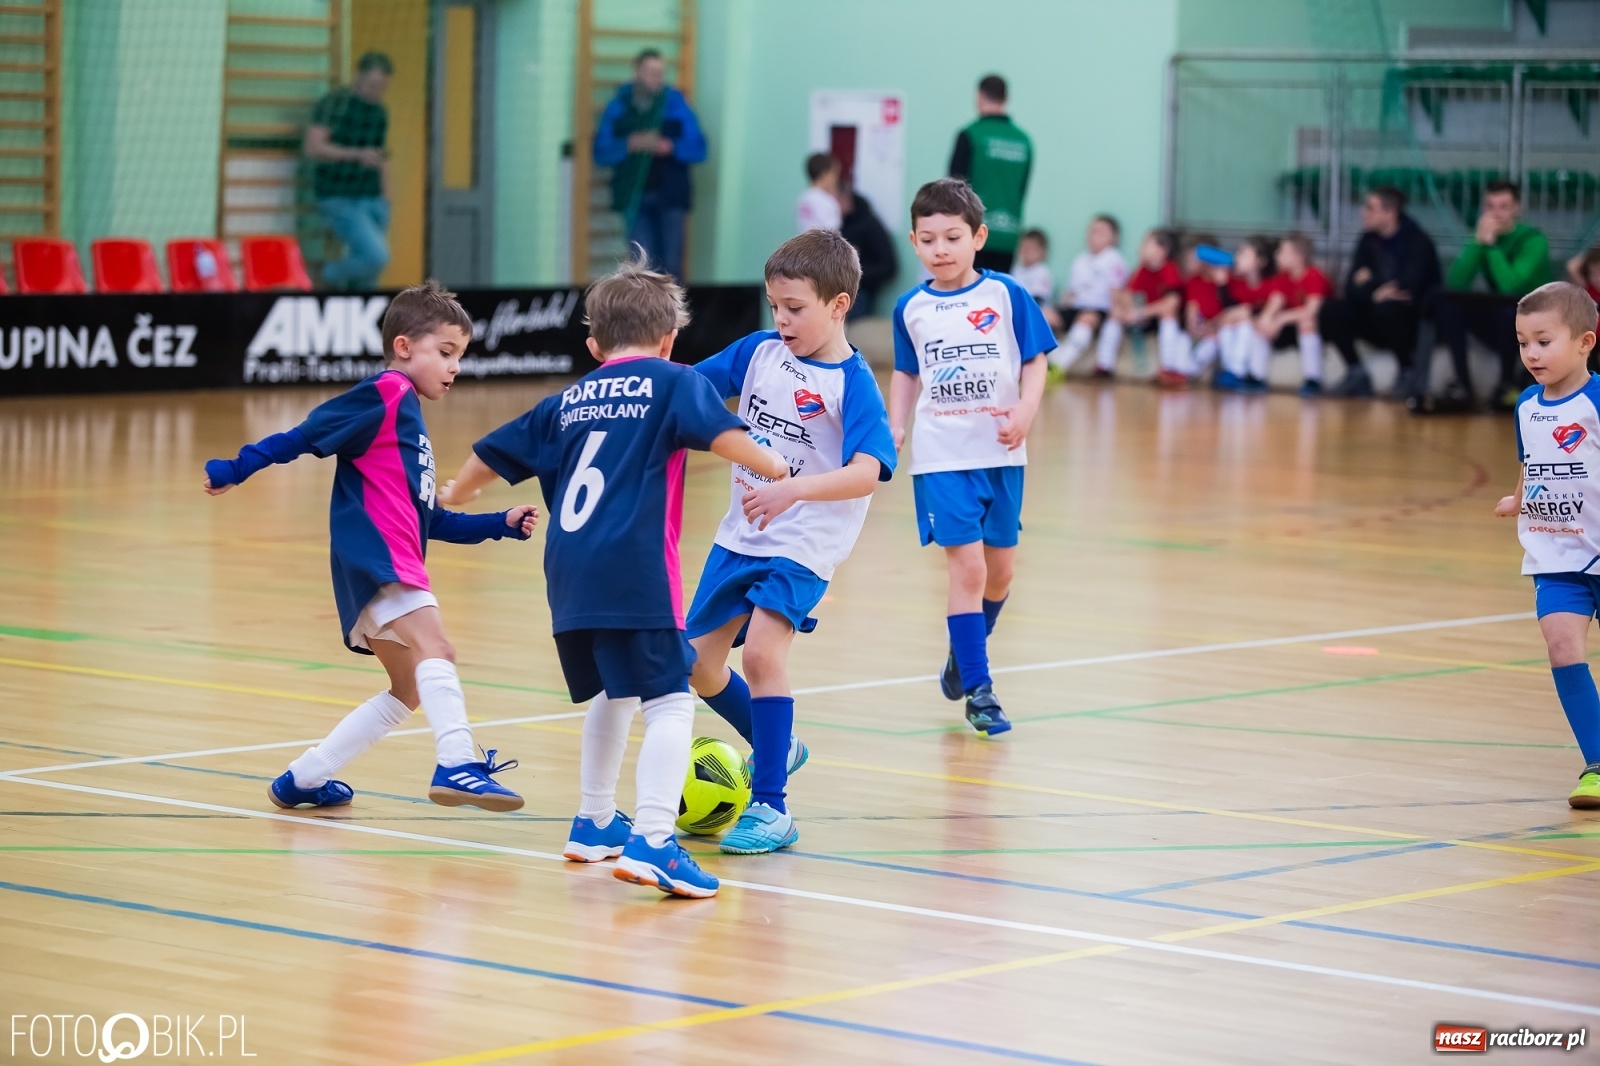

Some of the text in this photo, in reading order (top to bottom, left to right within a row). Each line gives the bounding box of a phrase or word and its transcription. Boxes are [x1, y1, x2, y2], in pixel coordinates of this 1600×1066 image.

[126, 313, 198, 367] ČEZ
[244, 296, 388, 356] AMK
[559, 375, 653, 410] FORTECA
[931, 379, 997, 400] ENERGY
[559, 430, 608, 533] 6
[1538, 491, 1584, 500] BESKID
[1520, 500, 1584, 516] ENERGY
